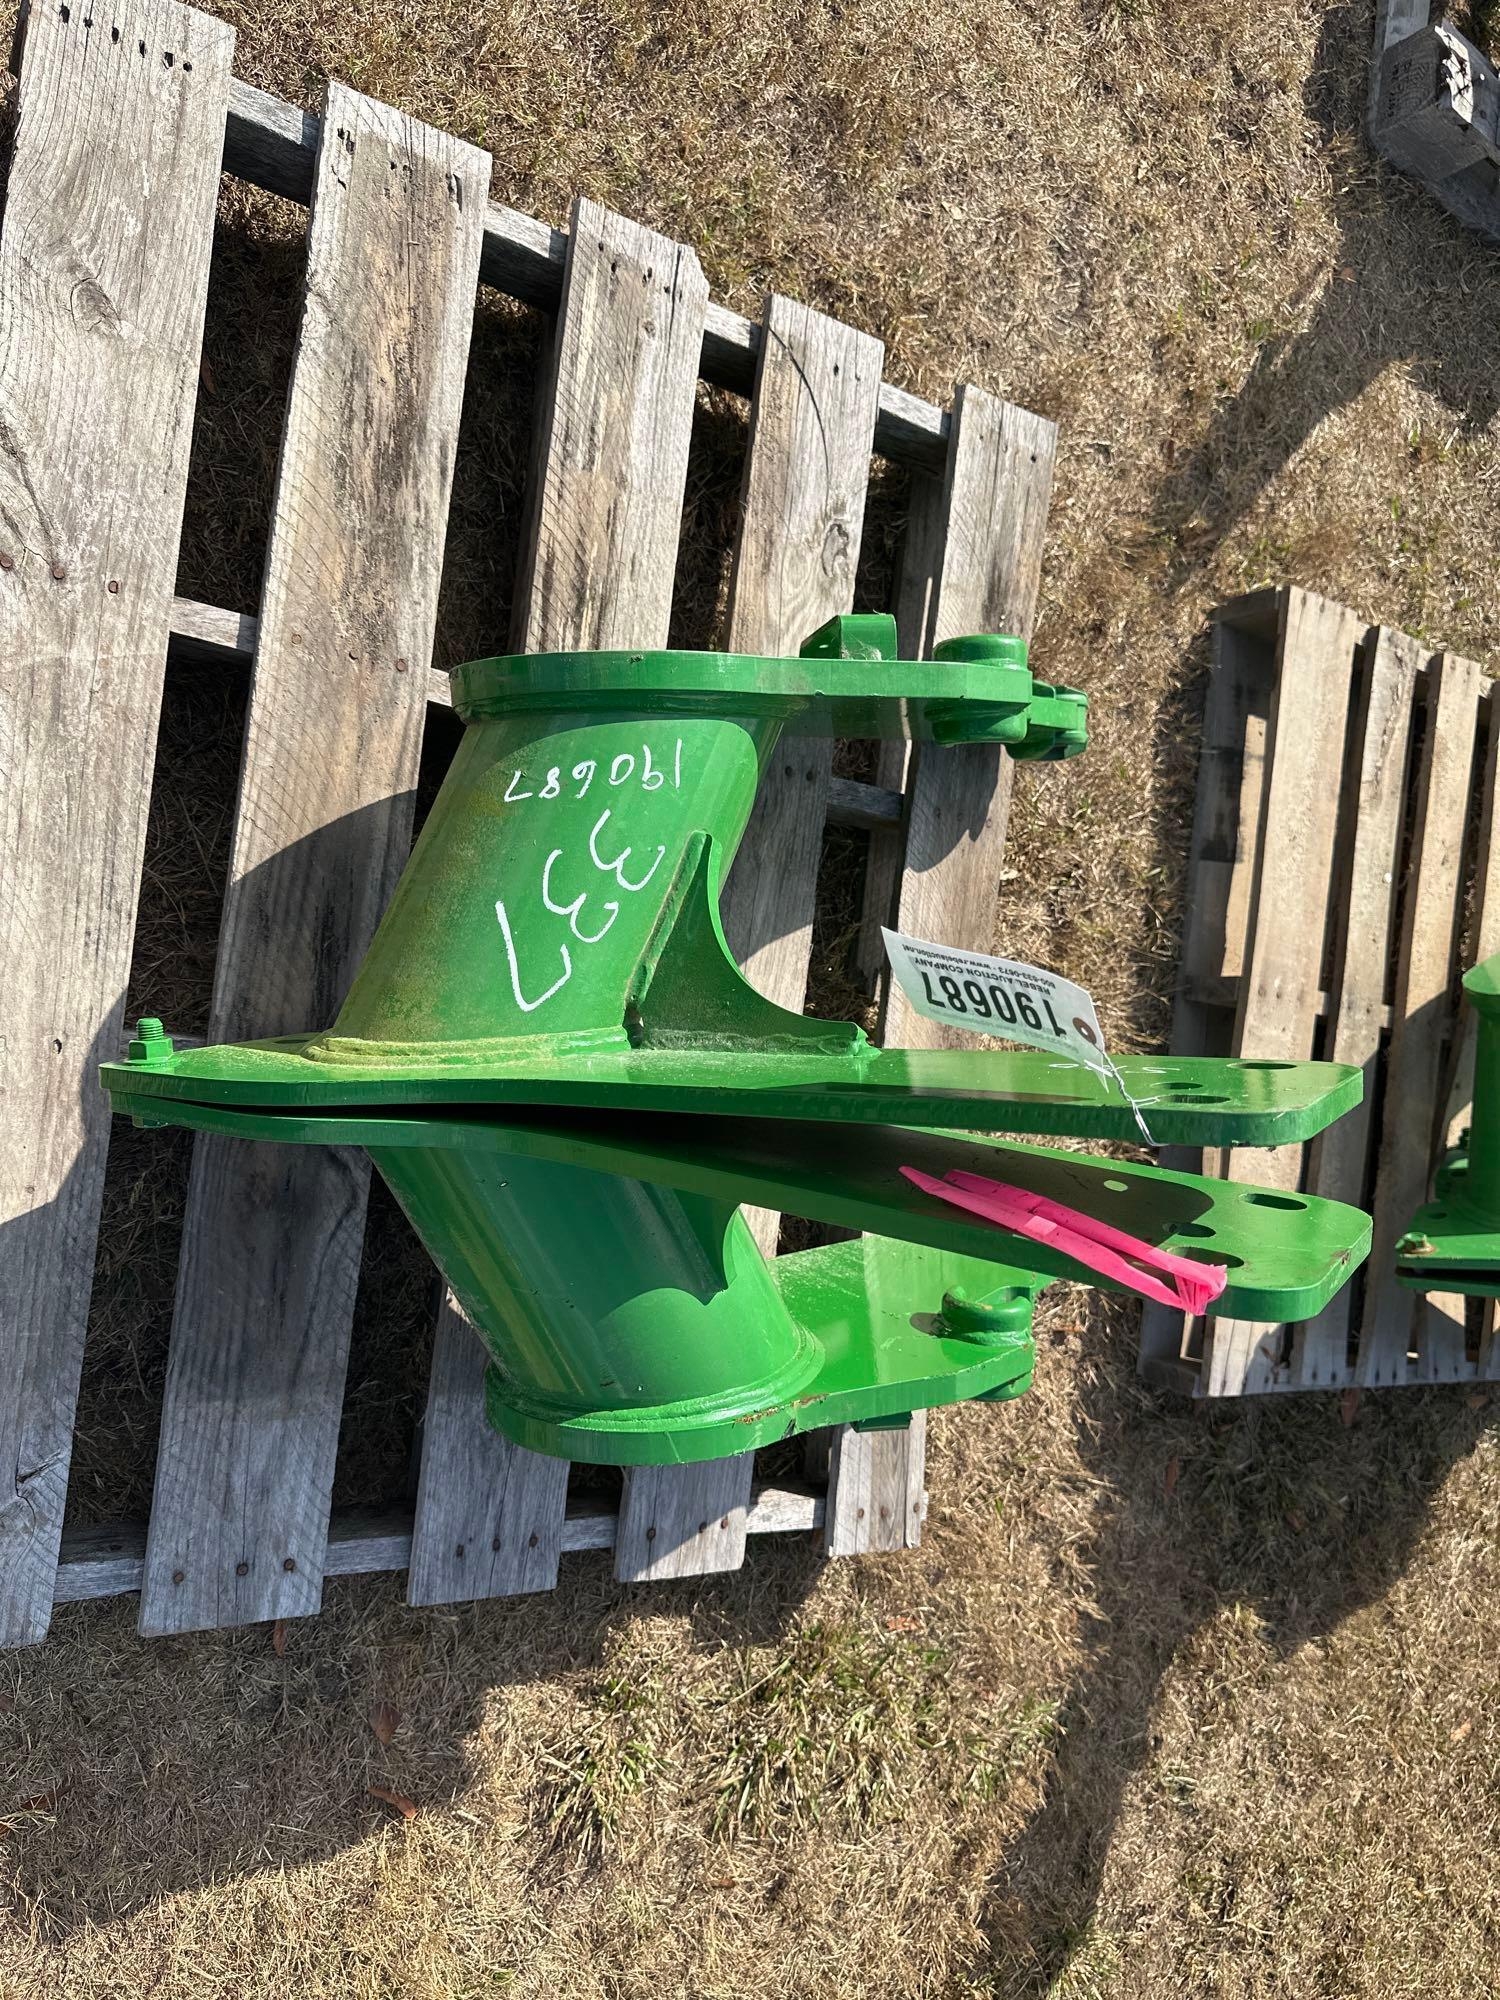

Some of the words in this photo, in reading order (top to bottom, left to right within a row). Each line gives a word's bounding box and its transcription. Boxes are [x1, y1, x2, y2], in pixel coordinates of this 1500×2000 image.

[503, 738, 683, 803] 190687
[494, 808, 666, 1013] 337
[902, 944, 992, 970] www.rebelauction.net
[914, 957, 965, 974] COMPANY
[966, 967, 1014, 986] AUCTION
[1015, 977, 1051, 995] REBEL
[920, 971, 1067, 1038] 190687
